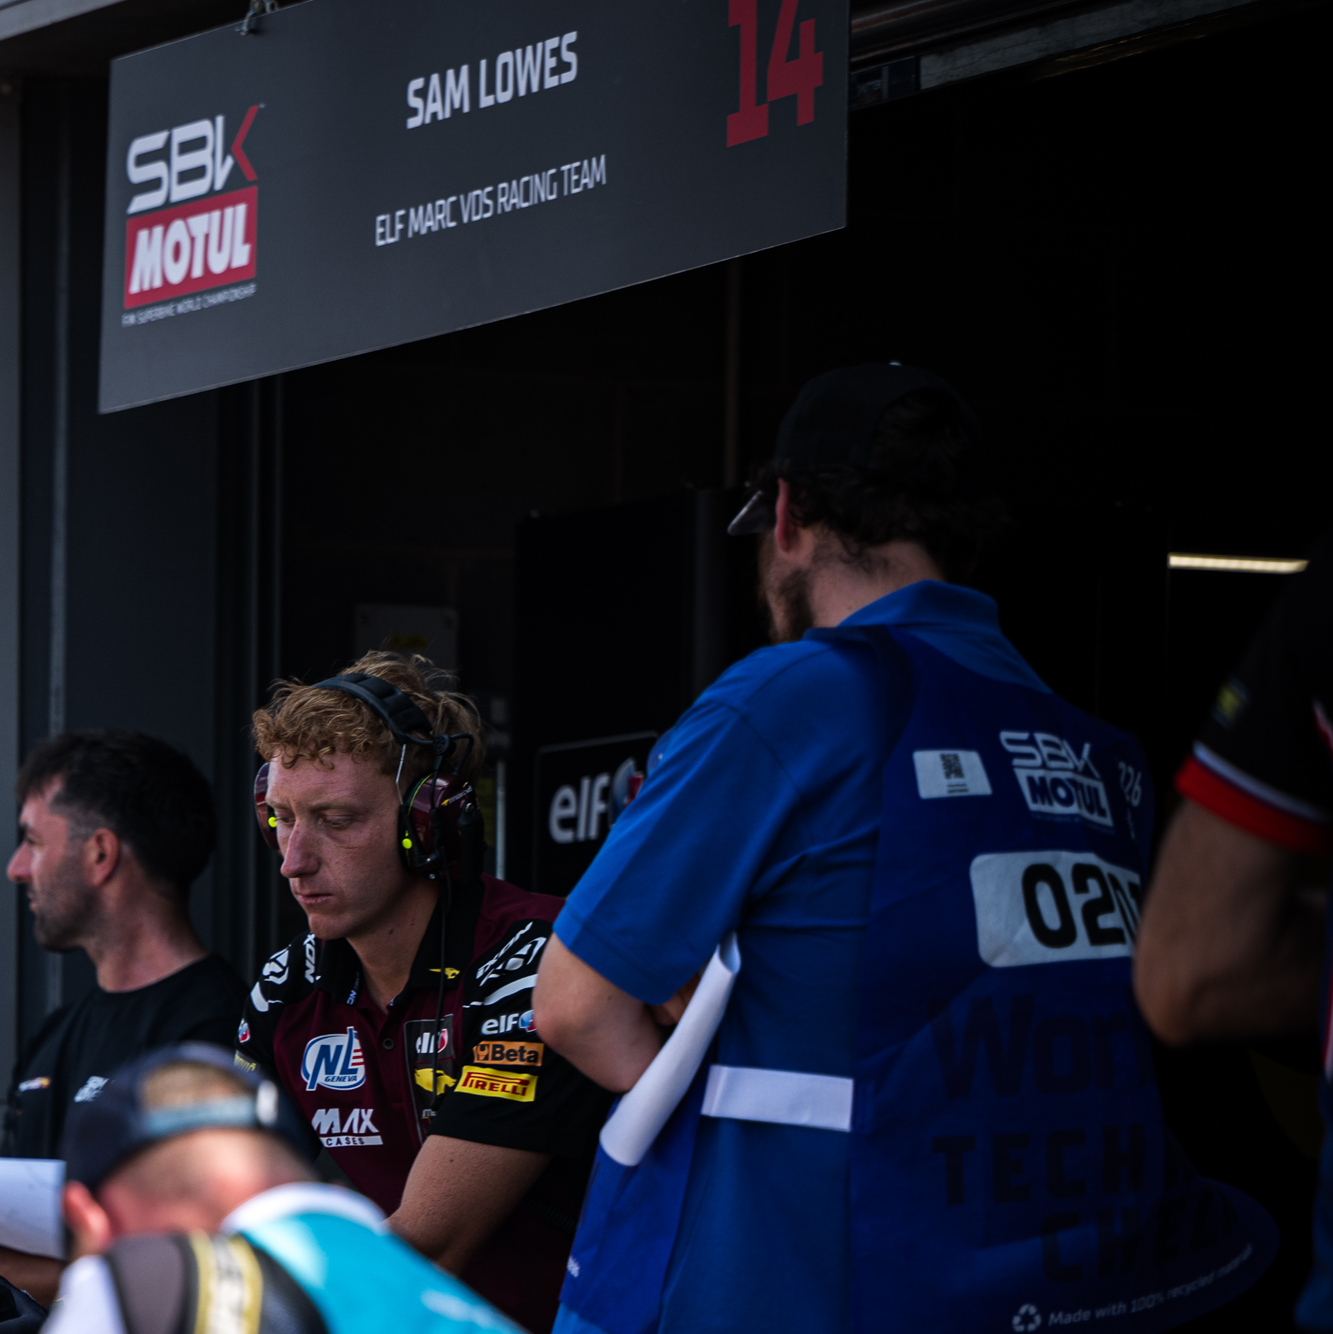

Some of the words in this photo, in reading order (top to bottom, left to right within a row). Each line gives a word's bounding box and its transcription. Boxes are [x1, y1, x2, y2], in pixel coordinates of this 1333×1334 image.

[406, 64, 470, 130] SAM
[479, 31, 578, 109] LOWES
[726, 0, 824, 148] 14
[126, 105, 259, 215] SBK
[376, 209, 407, 247] ELF
[408, 196, 458, 240] MARC
[459, 186, 494, 225] VDS
[497, 169, 558, 216] RACING
[559, 154, 607, 197] TEAM
[129, 203, 251, 294] MOTUL
[1000, 731, 1101, 780] SBK
[549, 773, 611, 845] elf
[1025, 775, 1109, 820] MOTUL
[480, 1013, 520, 1036] elf
[493, 1043, 539, 1064] Beta
[324, 1074, 358, 1083] GENEVA
[461, 1070, 531, 1097] PIRELLI
[311, 1108, 380, 1135] MAX
[324, 1136, 366, 1147] CASES
[1047, 1307, 1092, 1327] Made
[1094, 1301, 1128, 1321] with
